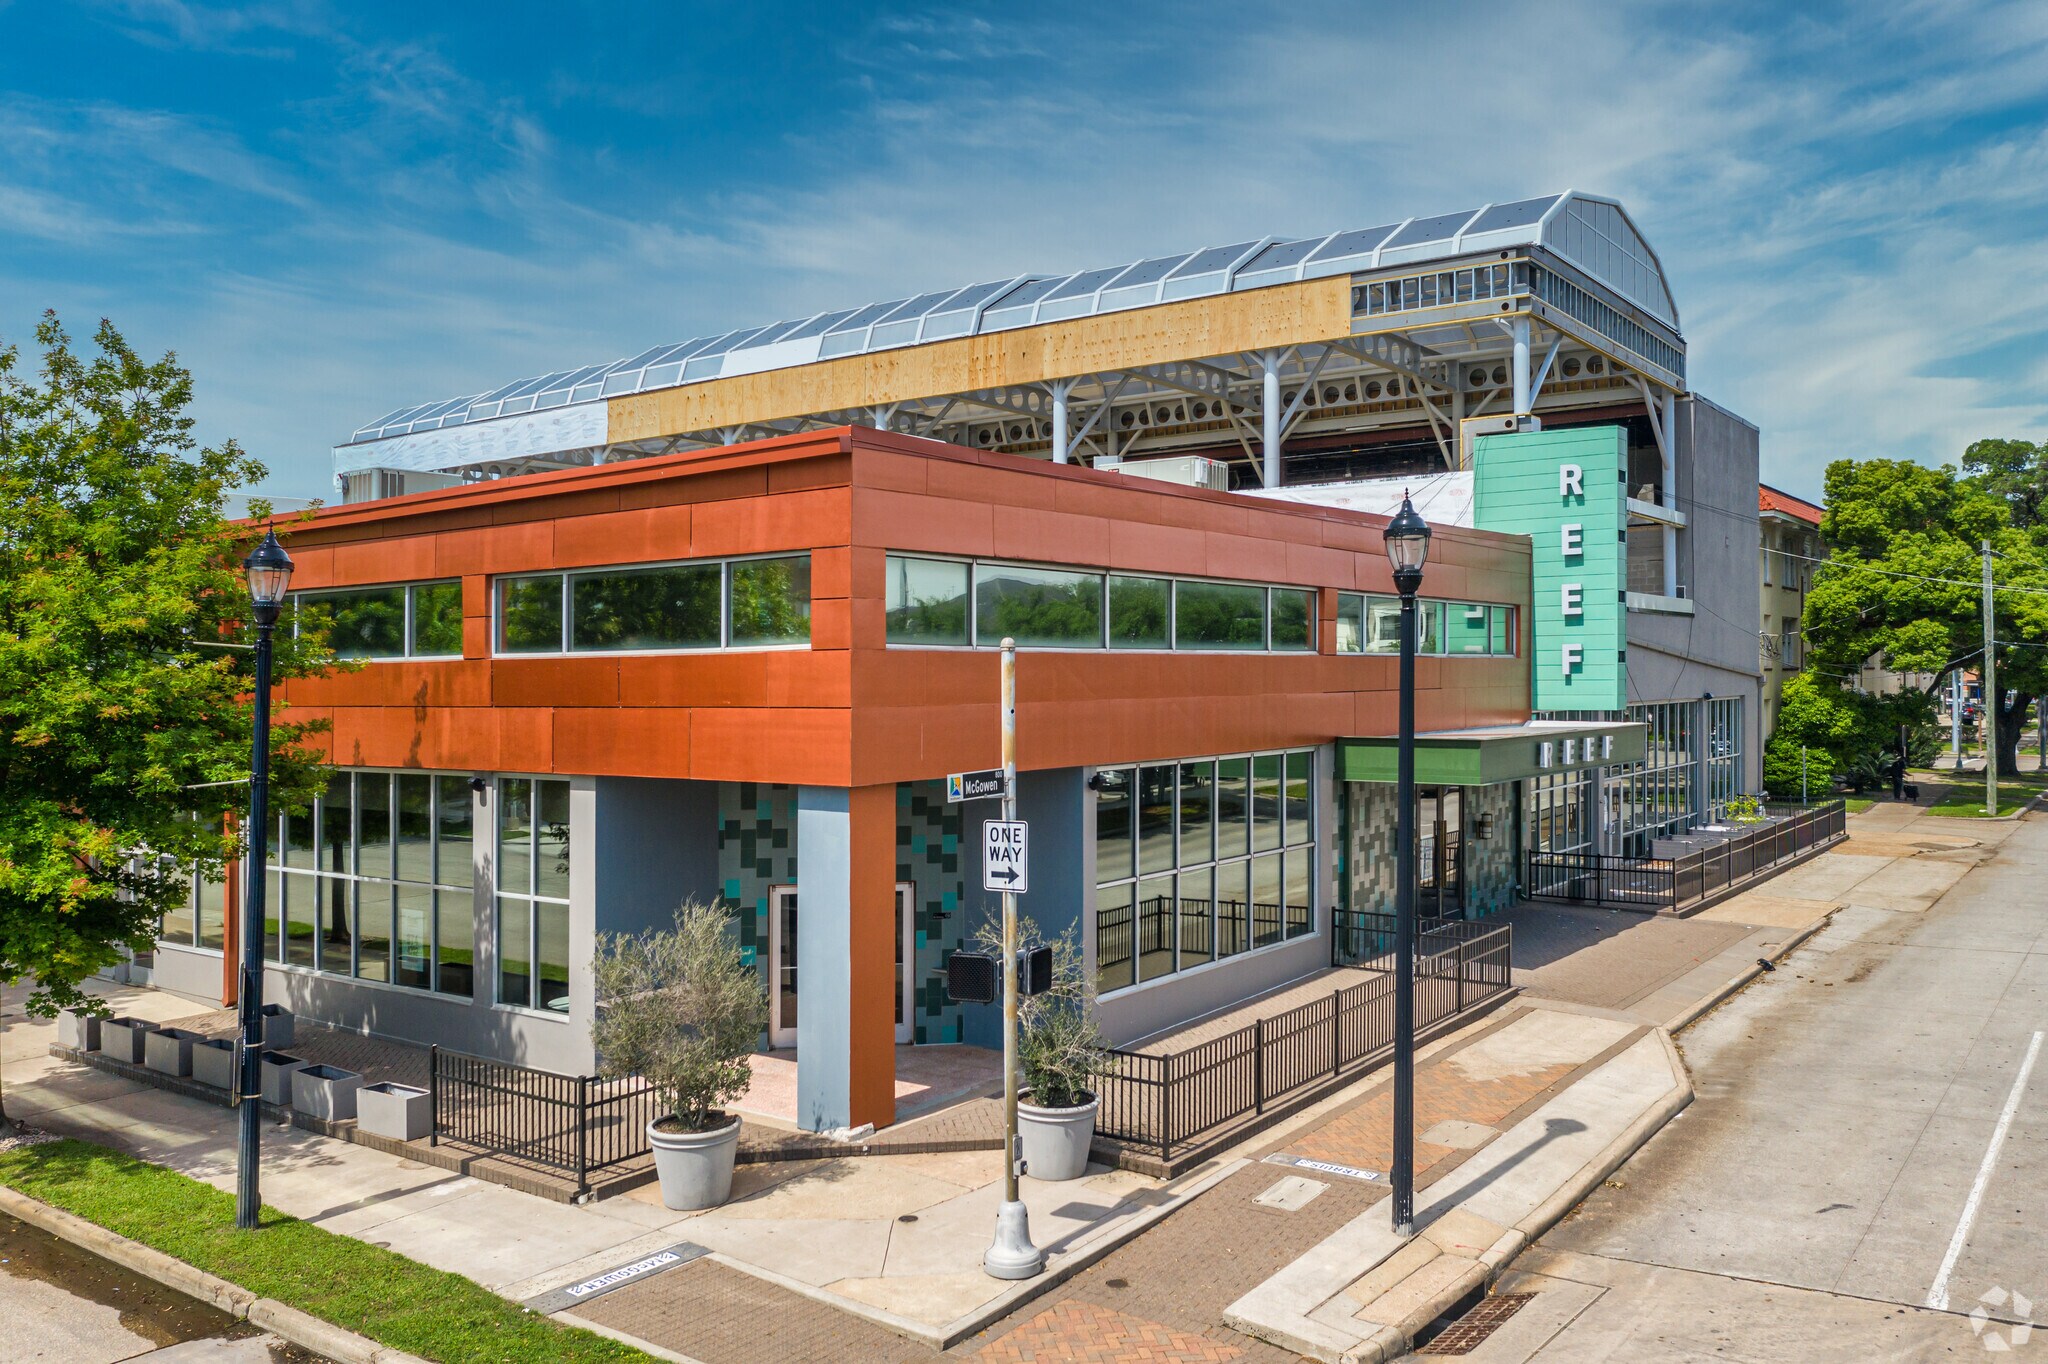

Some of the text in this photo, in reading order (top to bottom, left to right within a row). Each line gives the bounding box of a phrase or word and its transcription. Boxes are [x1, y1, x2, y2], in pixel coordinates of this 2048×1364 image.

[1559, 463, 1584, 676] REEF
[1540, 735, 1614, 769] REEF
[965, 779, 998, 795] McGowen
[990, 827, 1021, 844] ONE
[989, 846, 1022, 862] WAY
